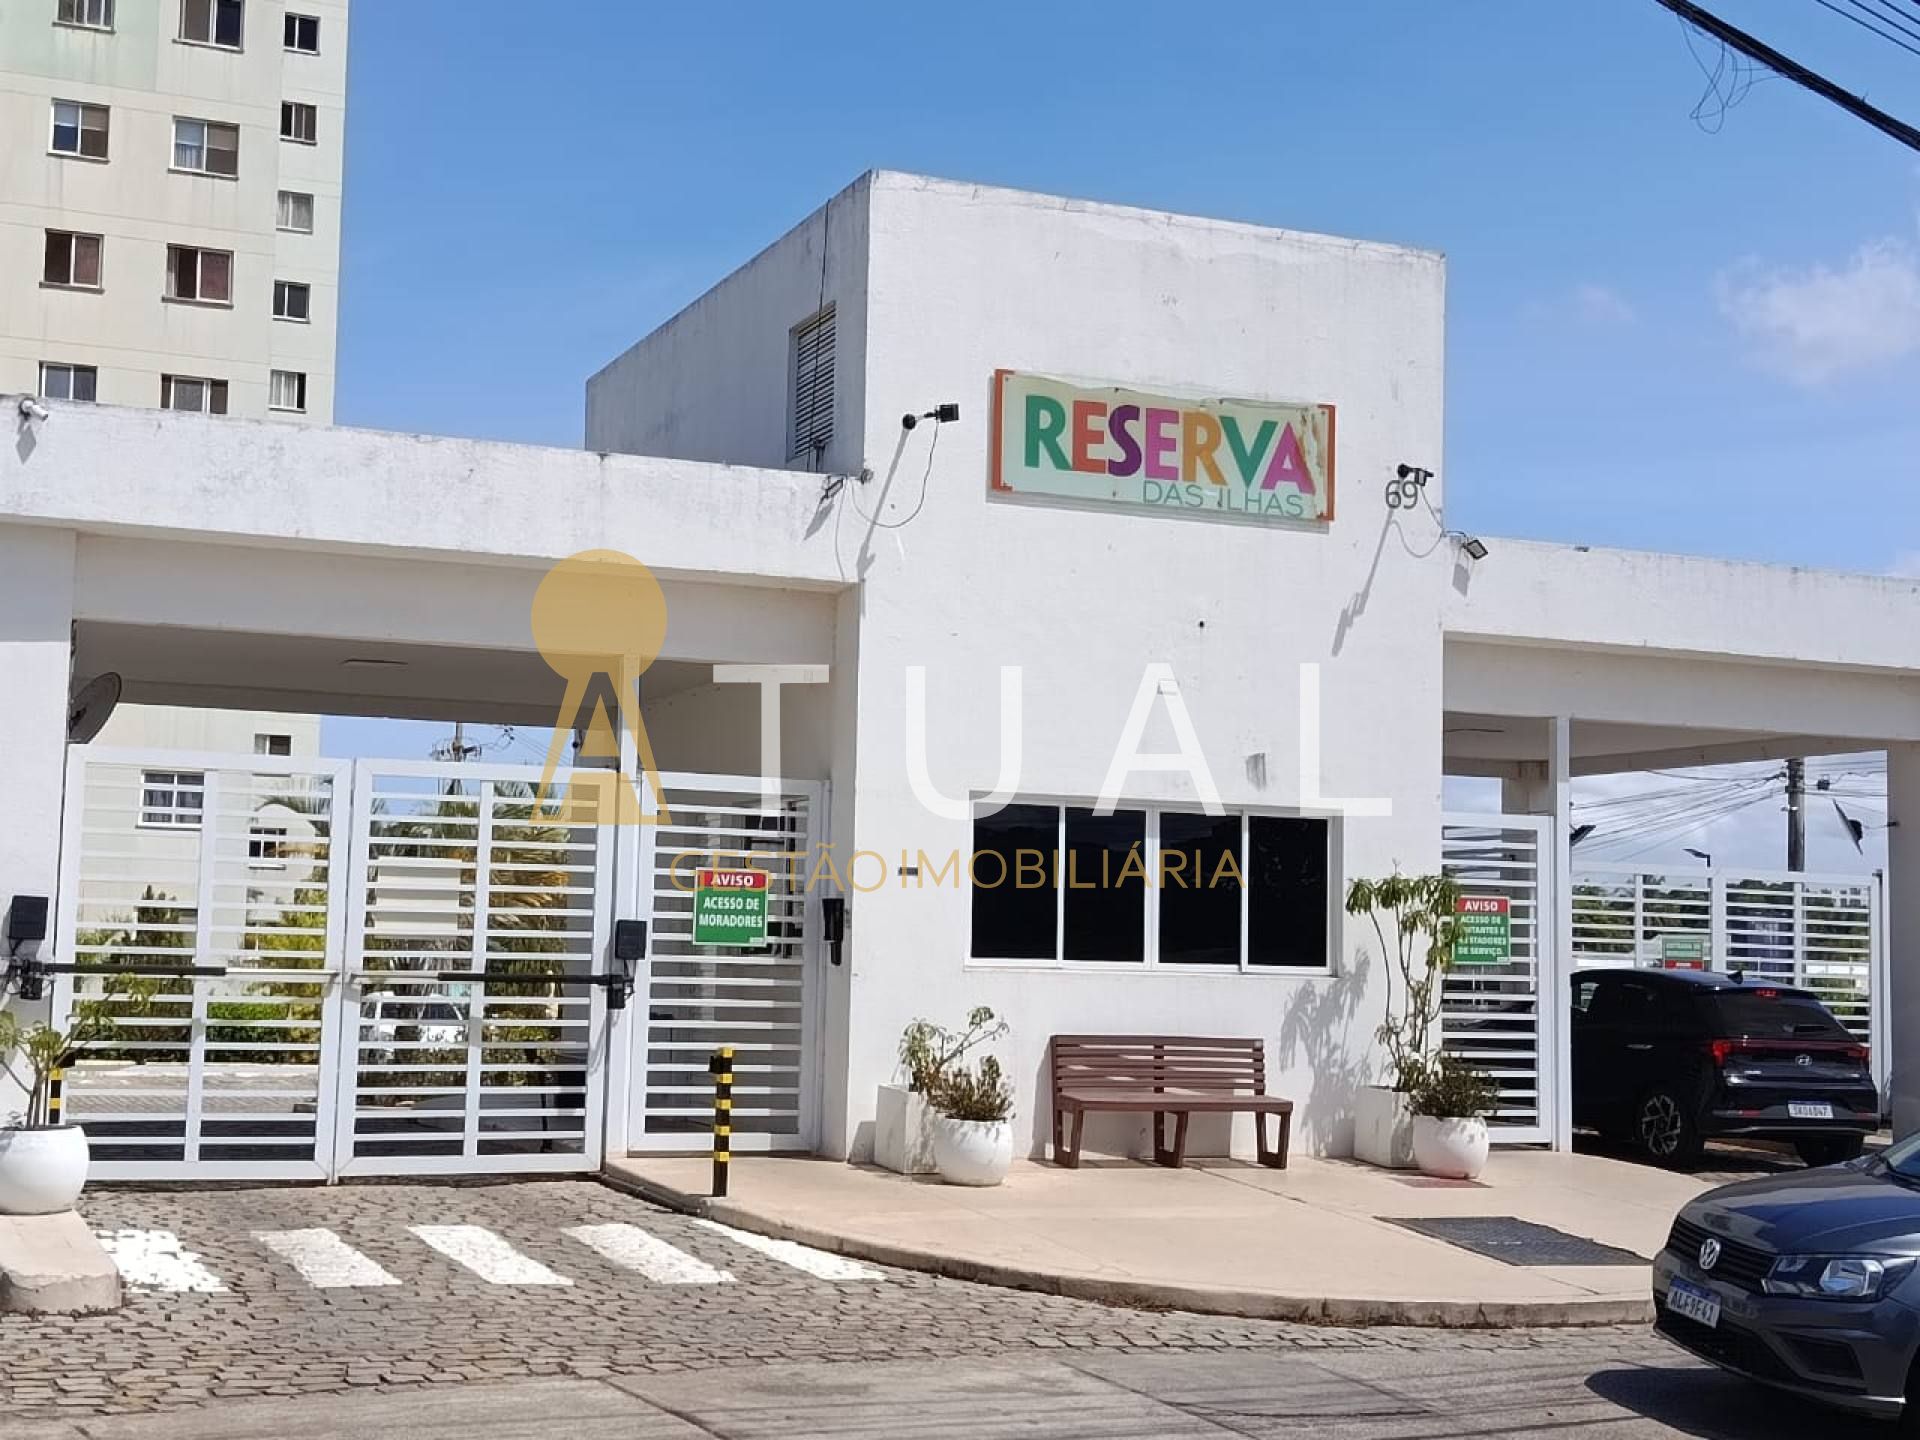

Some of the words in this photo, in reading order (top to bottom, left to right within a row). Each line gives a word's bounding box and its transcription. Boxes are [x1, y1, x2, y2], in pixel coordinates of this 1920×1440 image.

[1025, 395, 1316, 496] RESERVA
[1143, 480, 1203, 508] DAS
[1217, 487, 1304, 518] ILHAS
[1385, 479, 1418, 509] 69
[711, 874, 754, 886] AVISO
[703, 896, 743, 910] ACESSO
[746, 897, 760, 910] DE
[1464, 900, 1498, 911] AVISO
[698, 913, 763, 928] MORADORES
